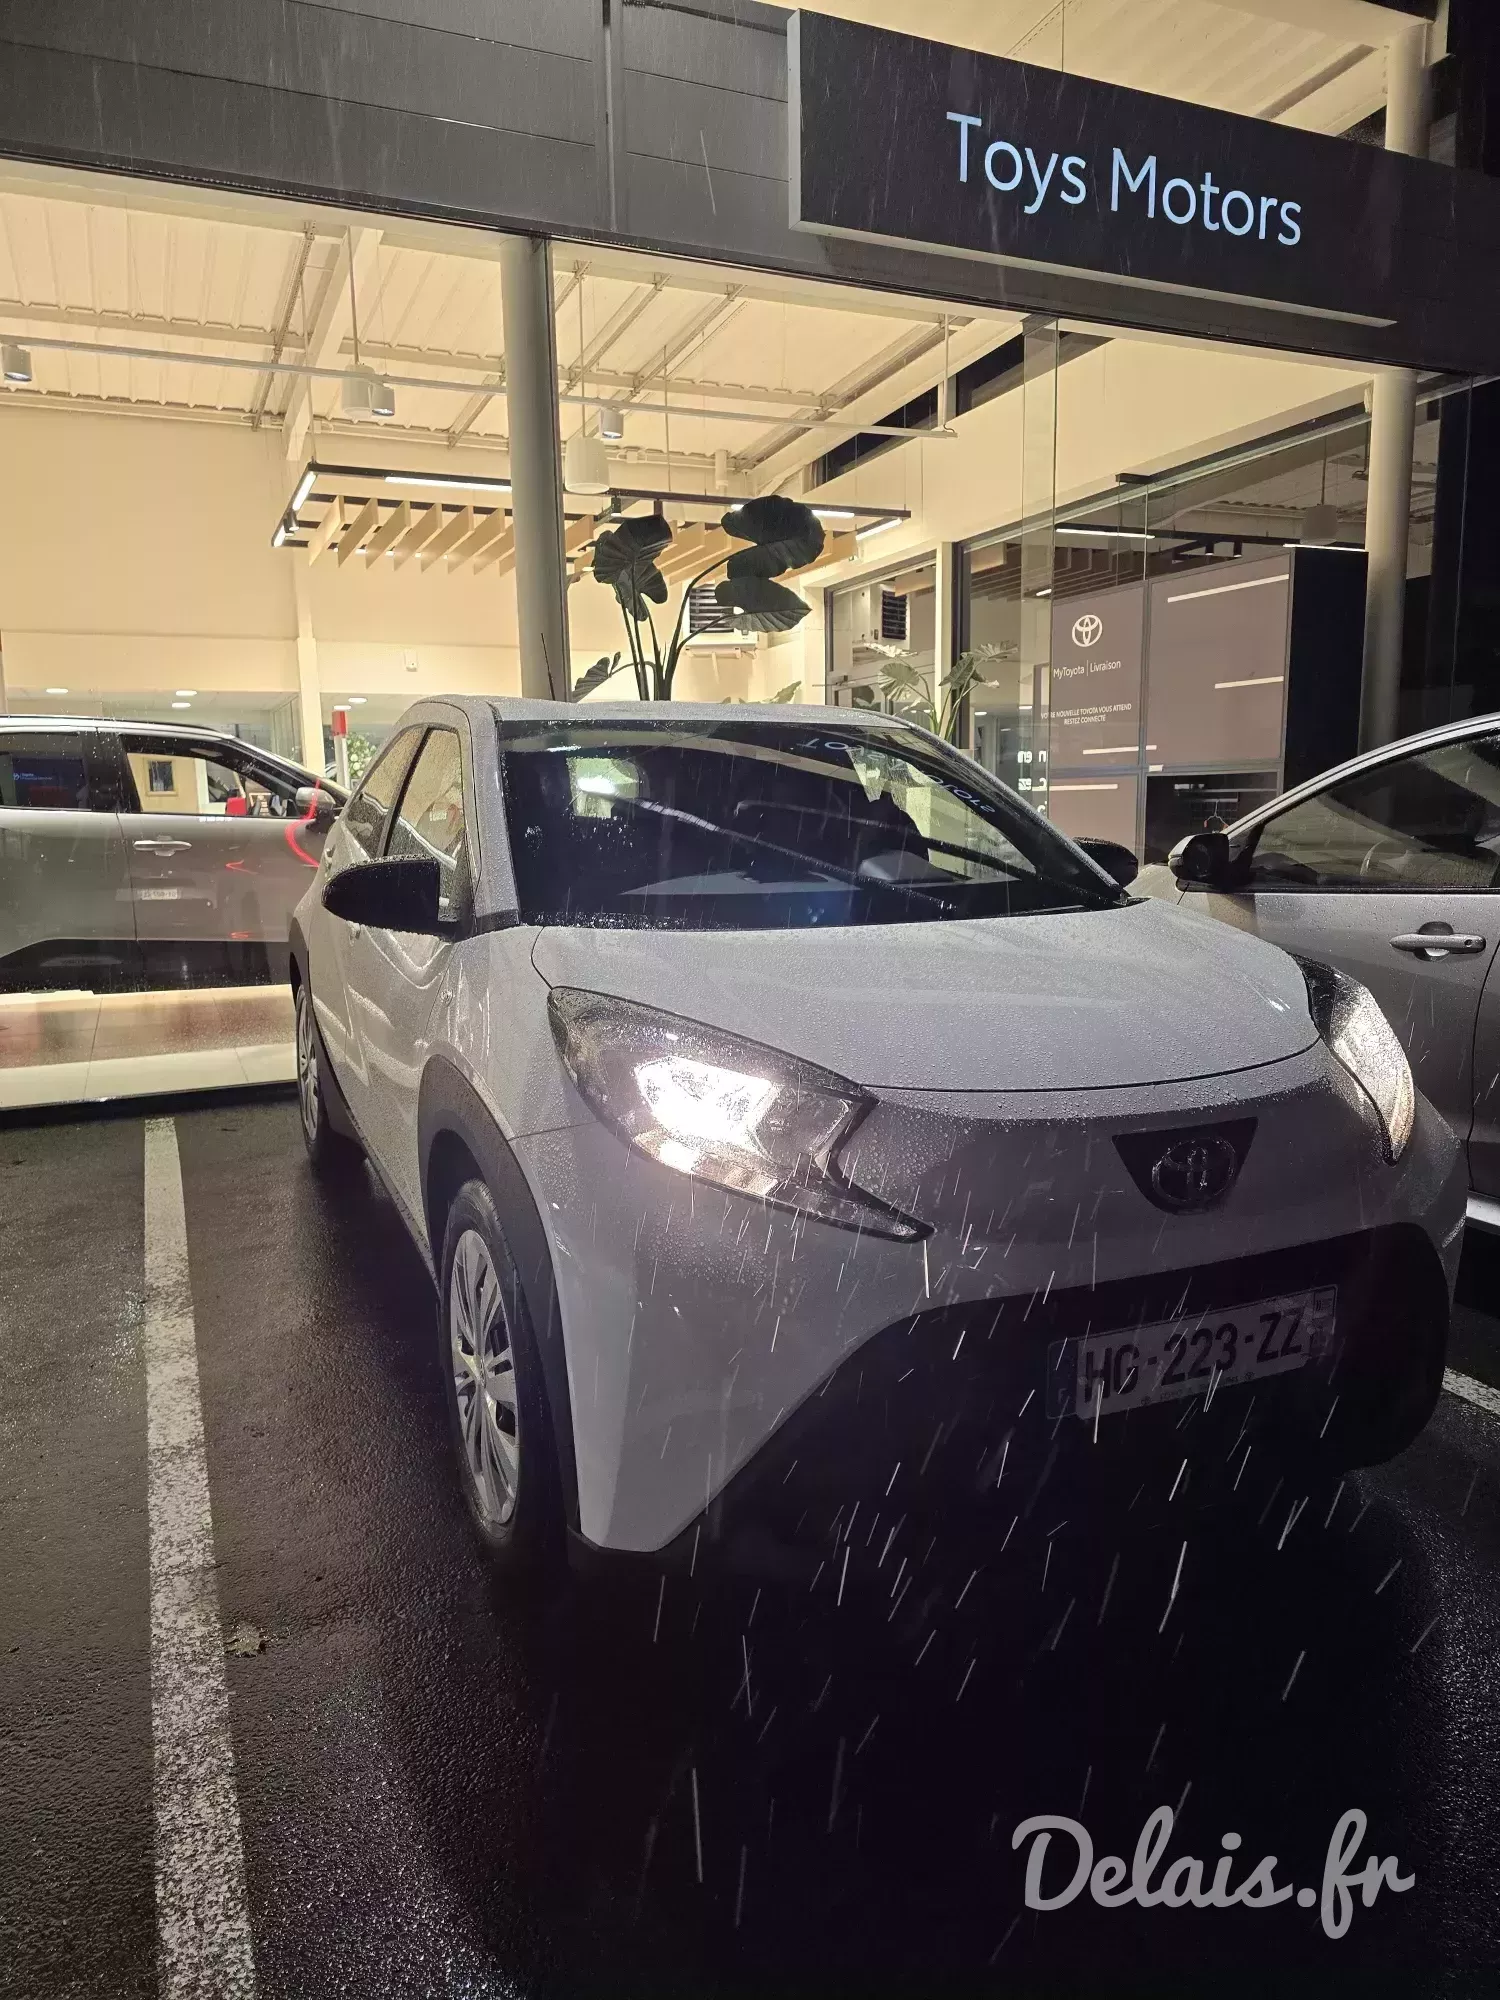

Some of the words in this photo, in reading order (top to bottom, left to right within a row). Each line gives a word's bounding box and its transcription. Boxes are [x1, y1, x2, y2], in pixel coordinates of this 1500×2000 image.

[946, 112, 1087, 214] Toys
[1110, 147, 1302, 246] Motors
[1053, 666, 1084, 679] MyToyota
[1090, 660, 1121, 673] Livraison
[1080, 707, 1098, 715] TOYOTA
